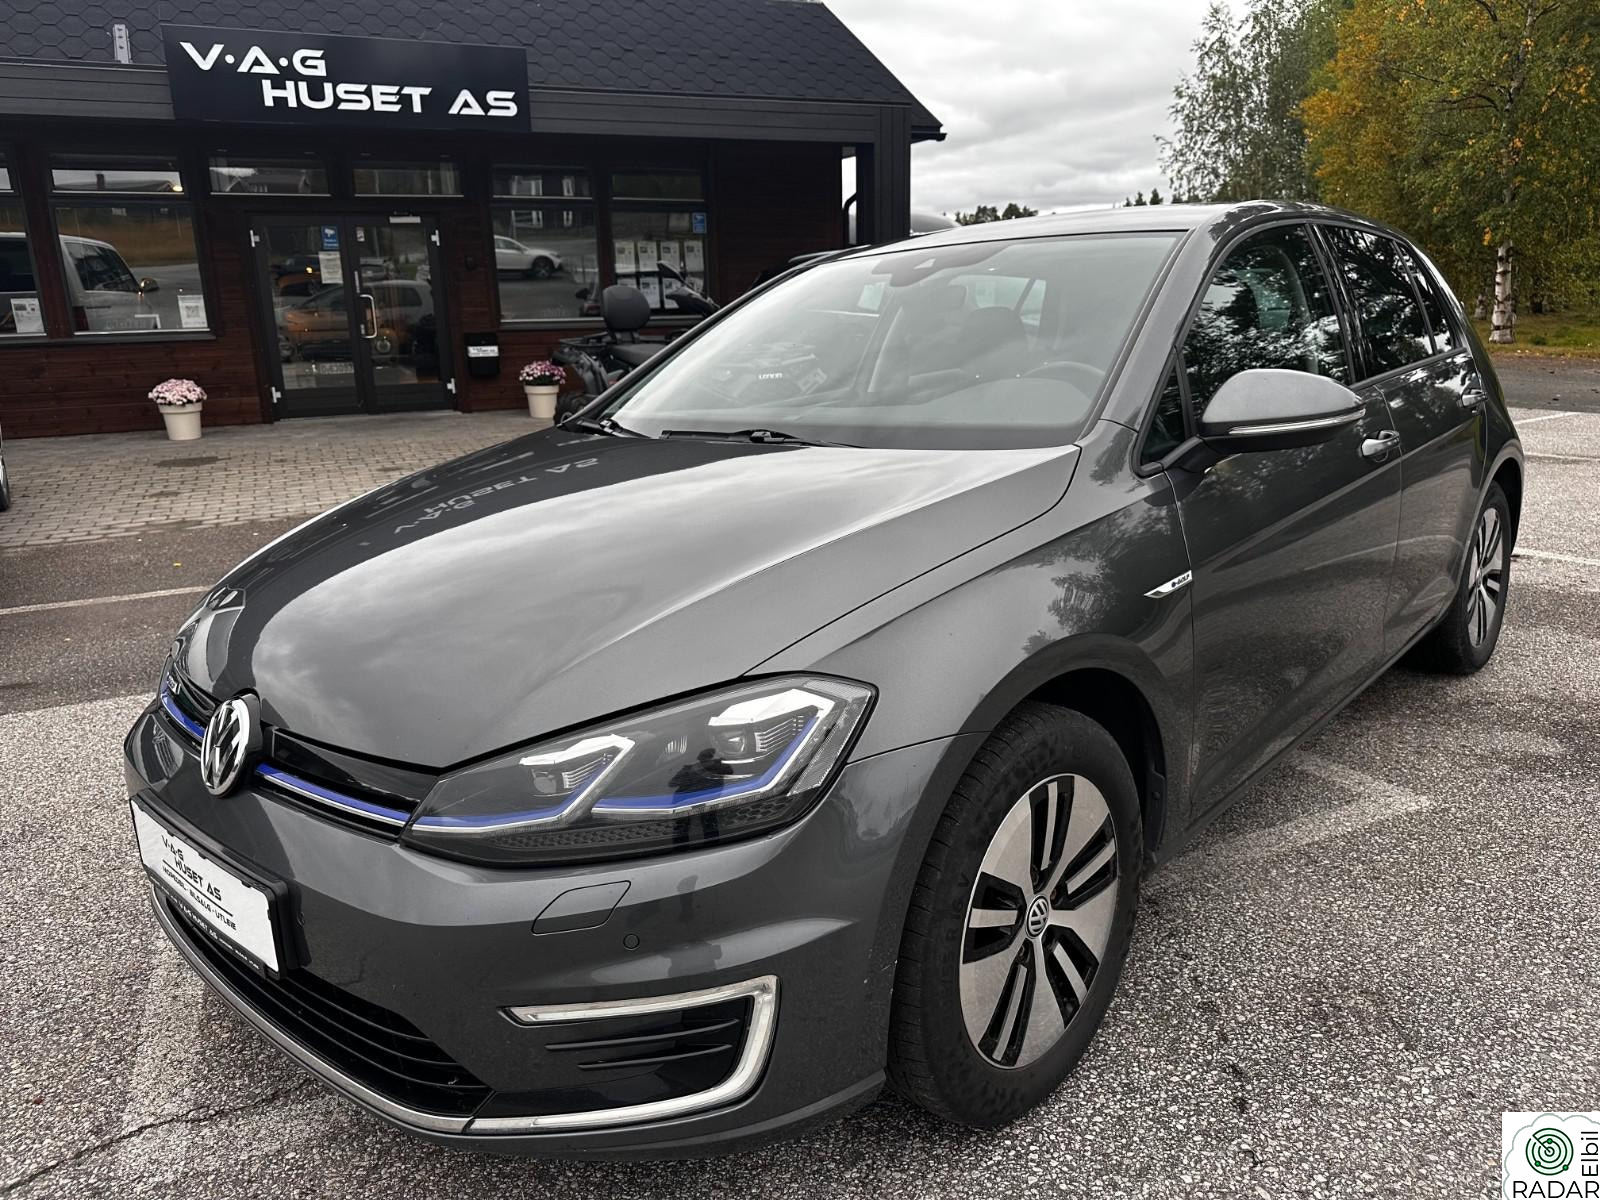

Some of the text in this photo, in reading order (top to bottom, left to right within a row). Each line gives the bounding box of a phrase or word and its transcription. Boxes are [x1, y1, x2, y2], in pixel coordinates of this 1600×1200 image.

[261, 79, 518, 117] HUSET AS
[174, 857, 204, 888] HUSET
[206, 882, 222, 902] AS
